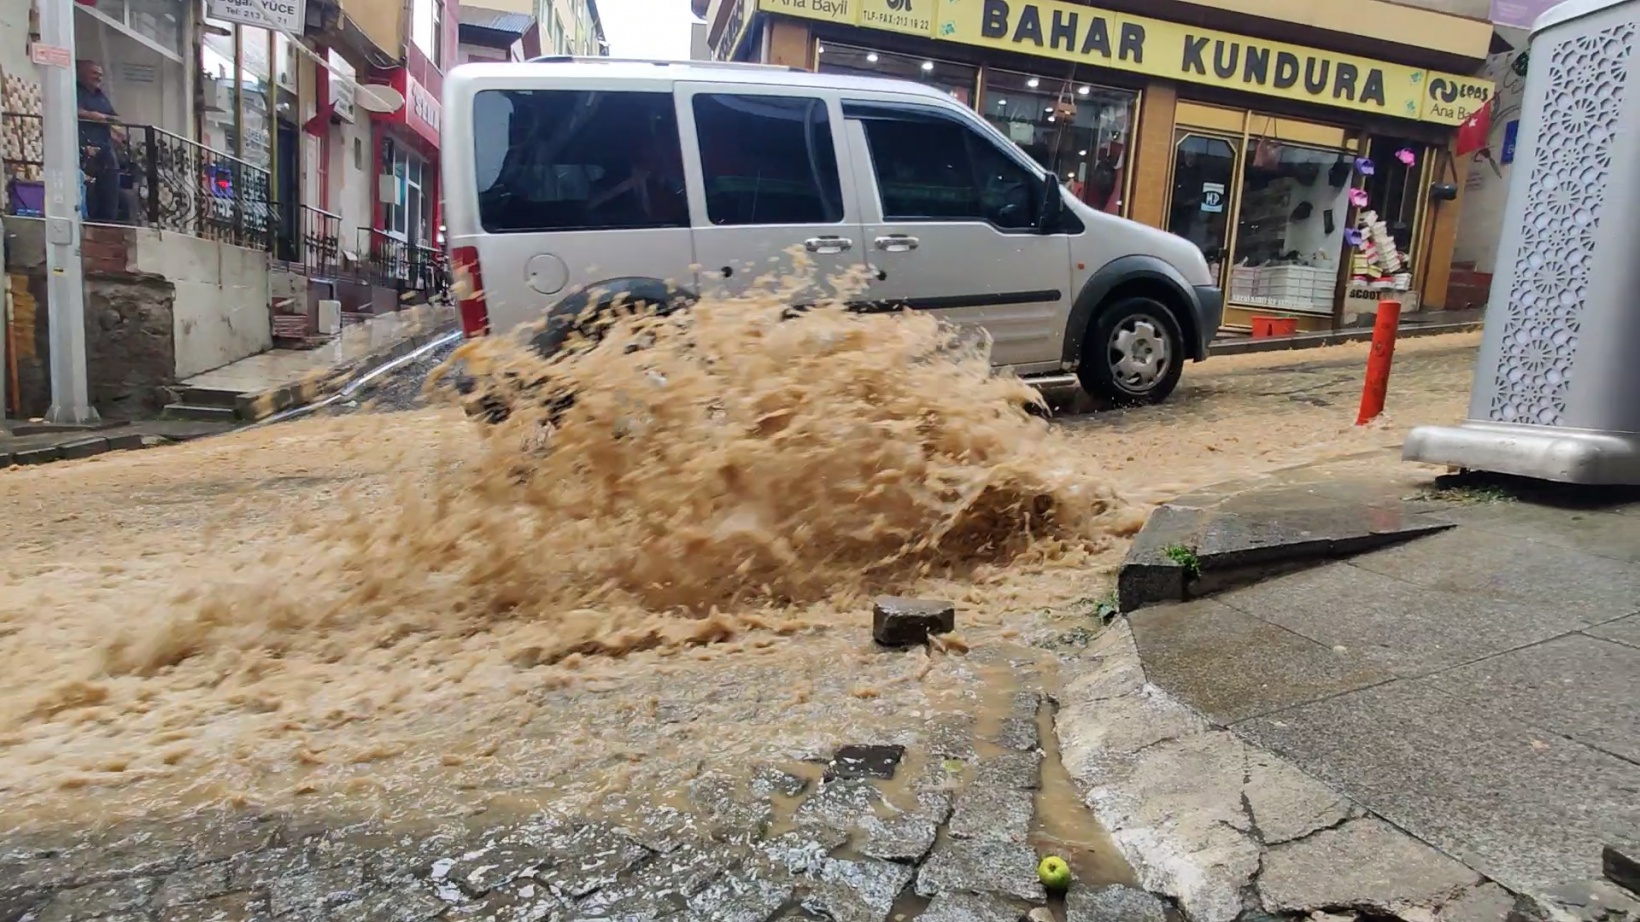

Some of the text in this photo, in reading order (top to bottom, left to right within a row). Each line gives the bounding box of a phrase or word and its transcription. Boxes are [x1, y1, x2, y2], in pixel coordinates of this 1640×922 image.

[811, 0, 849, 18] Bayii
[981, 0, 1387, 106] BAHAR KUNDURA
[1429, 103, 1454, 119] Ana
